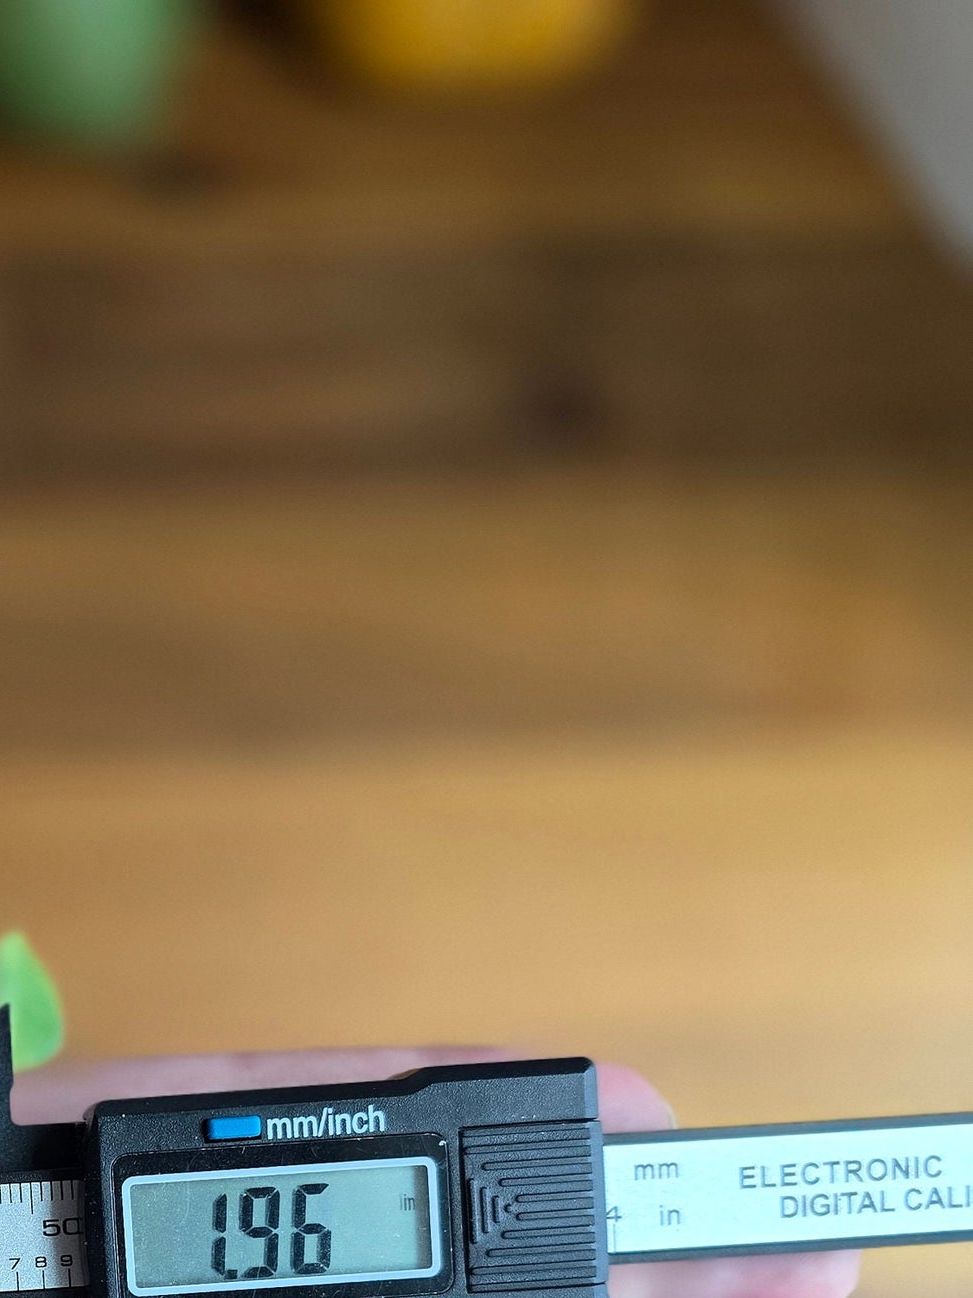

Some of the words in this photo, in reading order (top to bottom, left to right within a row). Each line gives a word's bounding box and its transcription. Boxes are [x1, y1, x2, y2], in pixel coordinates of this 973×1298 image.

[266, 1104, 386, 1140] mm/inch
[633, 1162, 679, 1181] mm
[738, 1154, 943, 1190] ELECTRONIC
[659, 1204, 681, 1227] in
[779, 1190, 896, 1219] DIGITAL
[42, 1217, 83, 1237] 50
[8, 1257, 21, 1270] 7
[35, 1256, 48, 1268] 8
[60, 1254, 73, 1267] 9
